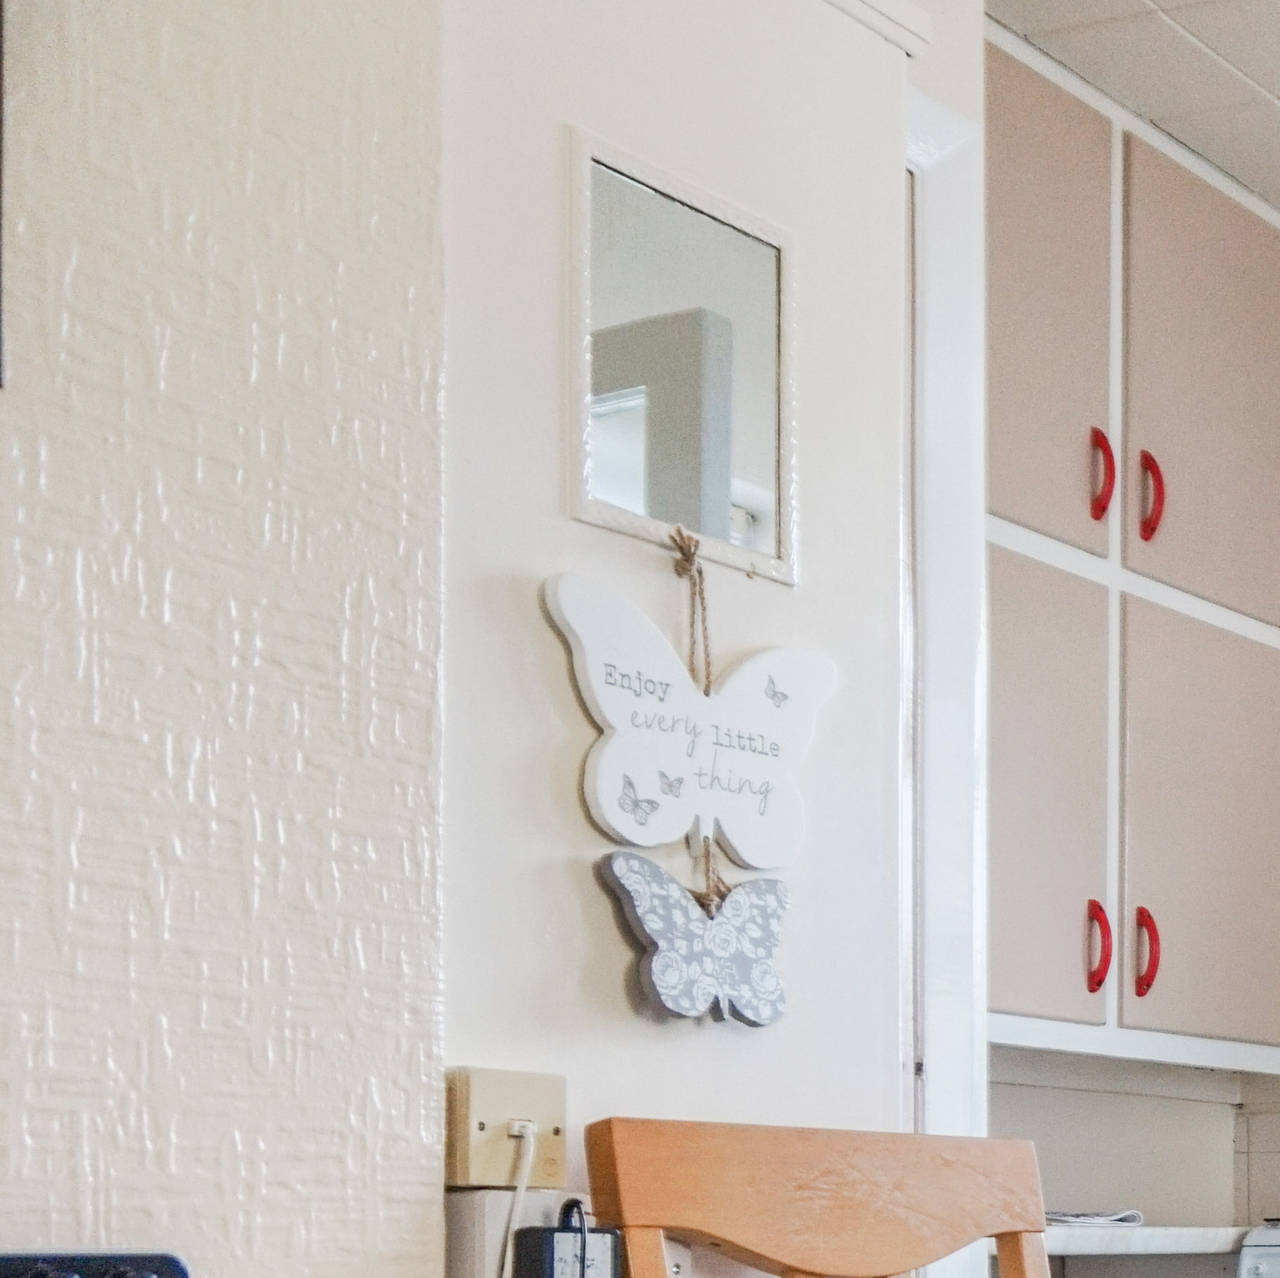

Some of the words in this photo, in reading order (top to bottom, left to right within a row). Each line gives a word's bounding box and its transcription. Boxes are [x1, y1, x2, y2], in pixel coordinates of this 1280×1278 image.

[604, 663, 671, 702] Enjoy
[630, 710, 703, 758] every
[712, 724, 780, 757] little
[693, 749, 773, 816] thing
